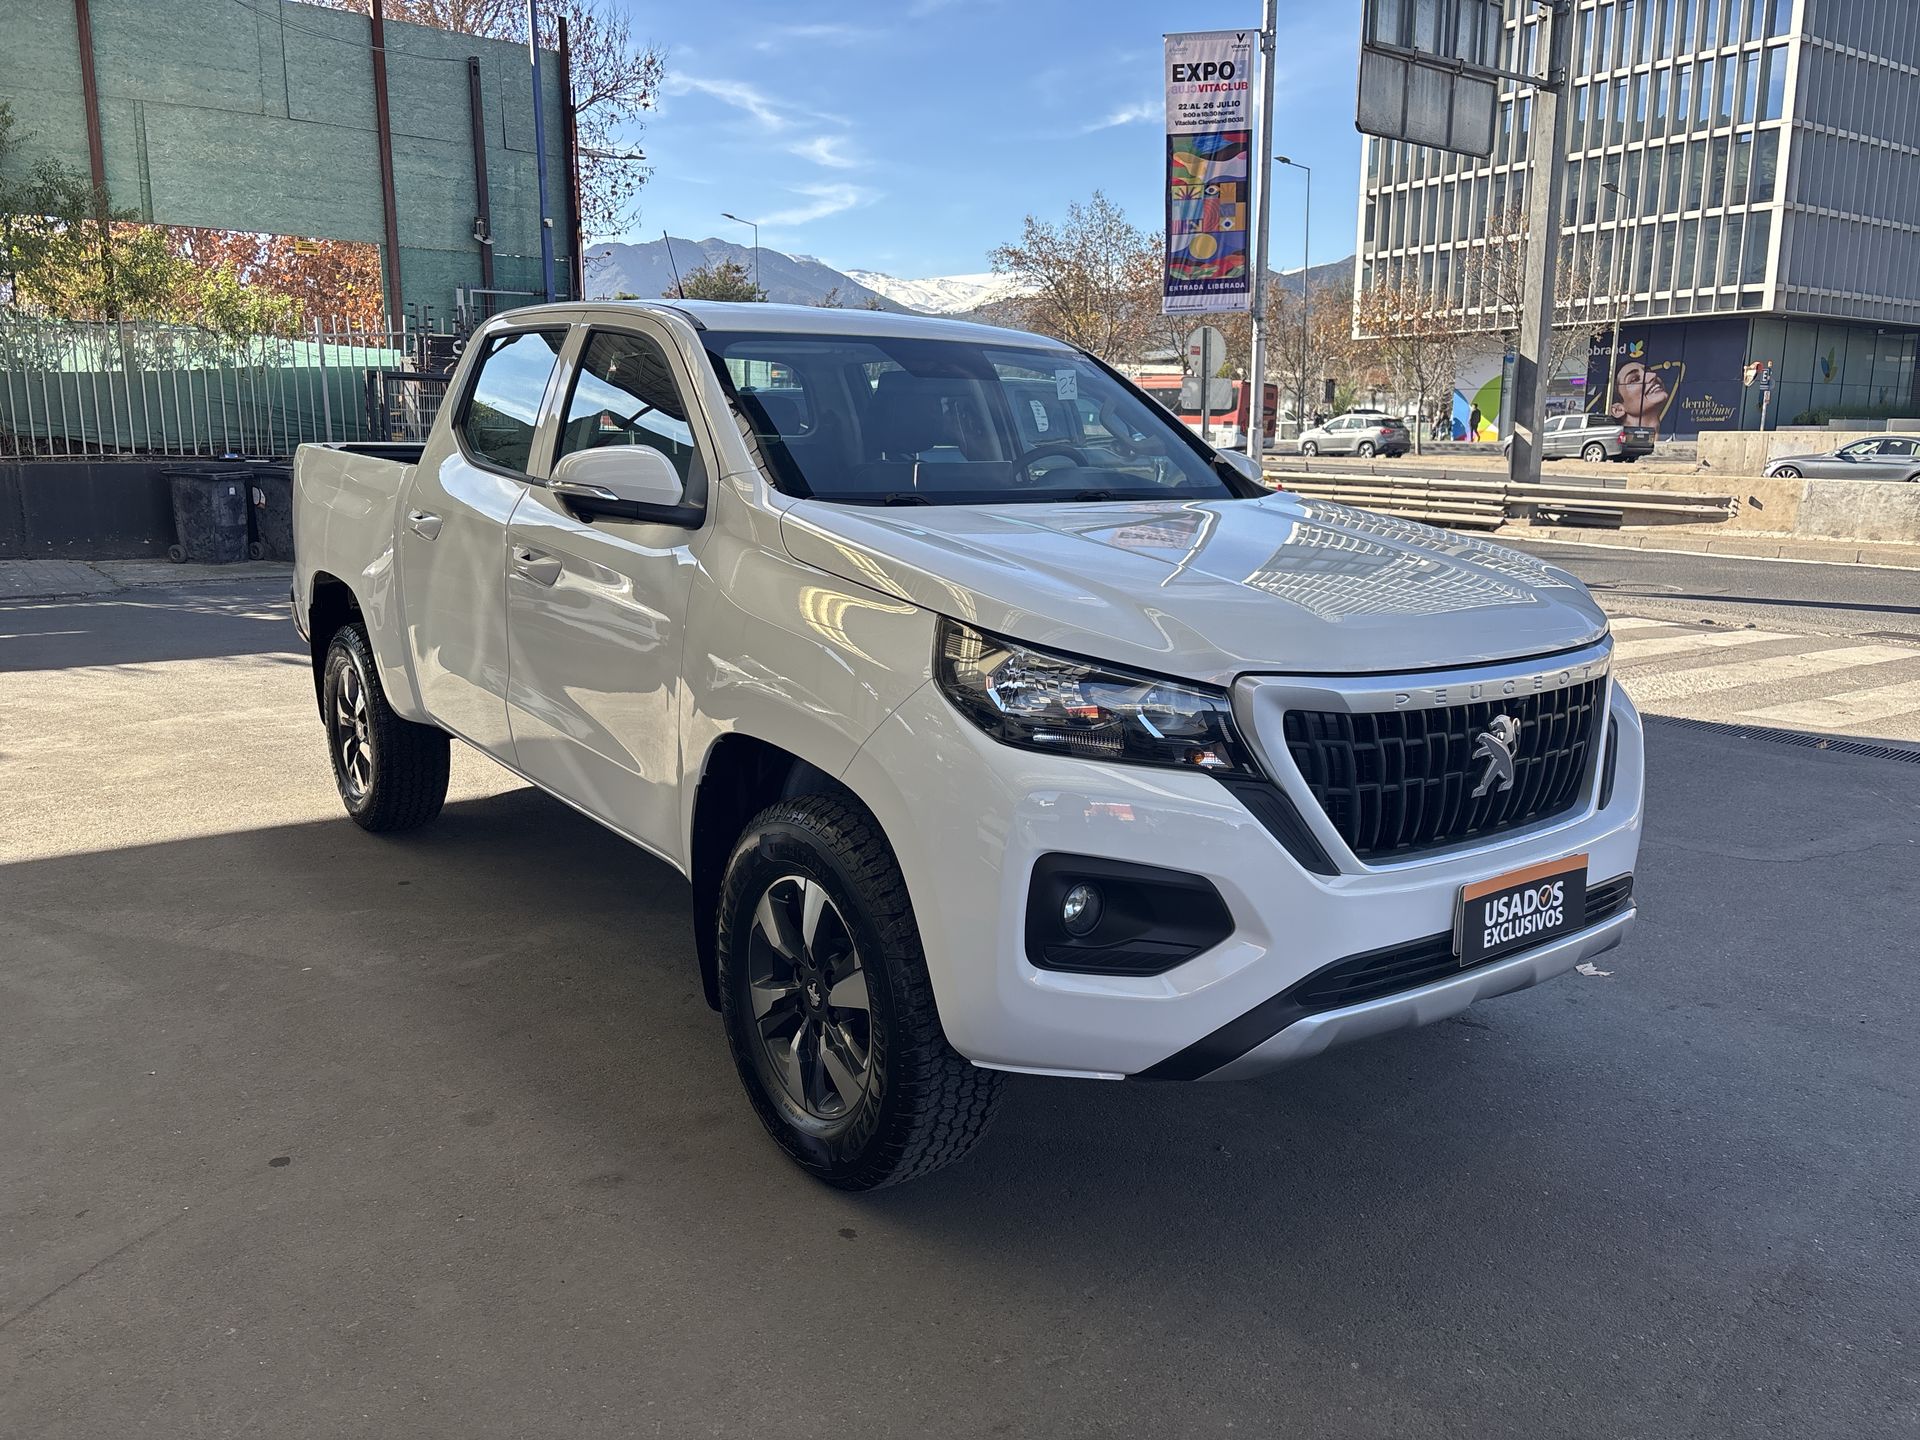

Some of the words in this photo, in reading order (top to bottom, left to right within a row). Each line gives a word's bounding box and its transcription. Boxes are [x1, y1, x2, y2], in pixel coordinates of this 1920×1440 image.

[1172, 61, 1235, 82] EXPO
[1198, 82, 1248, 92] VITACLUB
[1217, 100, 1241, 109] JULIO
[1169, 284, 1204, 292] ENTRADA
[1207, 282, 1245, 290] LIBERADA
[1060, 375, 1075, 395] 23
[1393, 666, 1591, 710] PEUGEOT
[1484, 880, 1564, 927] USADOS
[1483, 906, 1563, 949] EXCLUSIVOS
